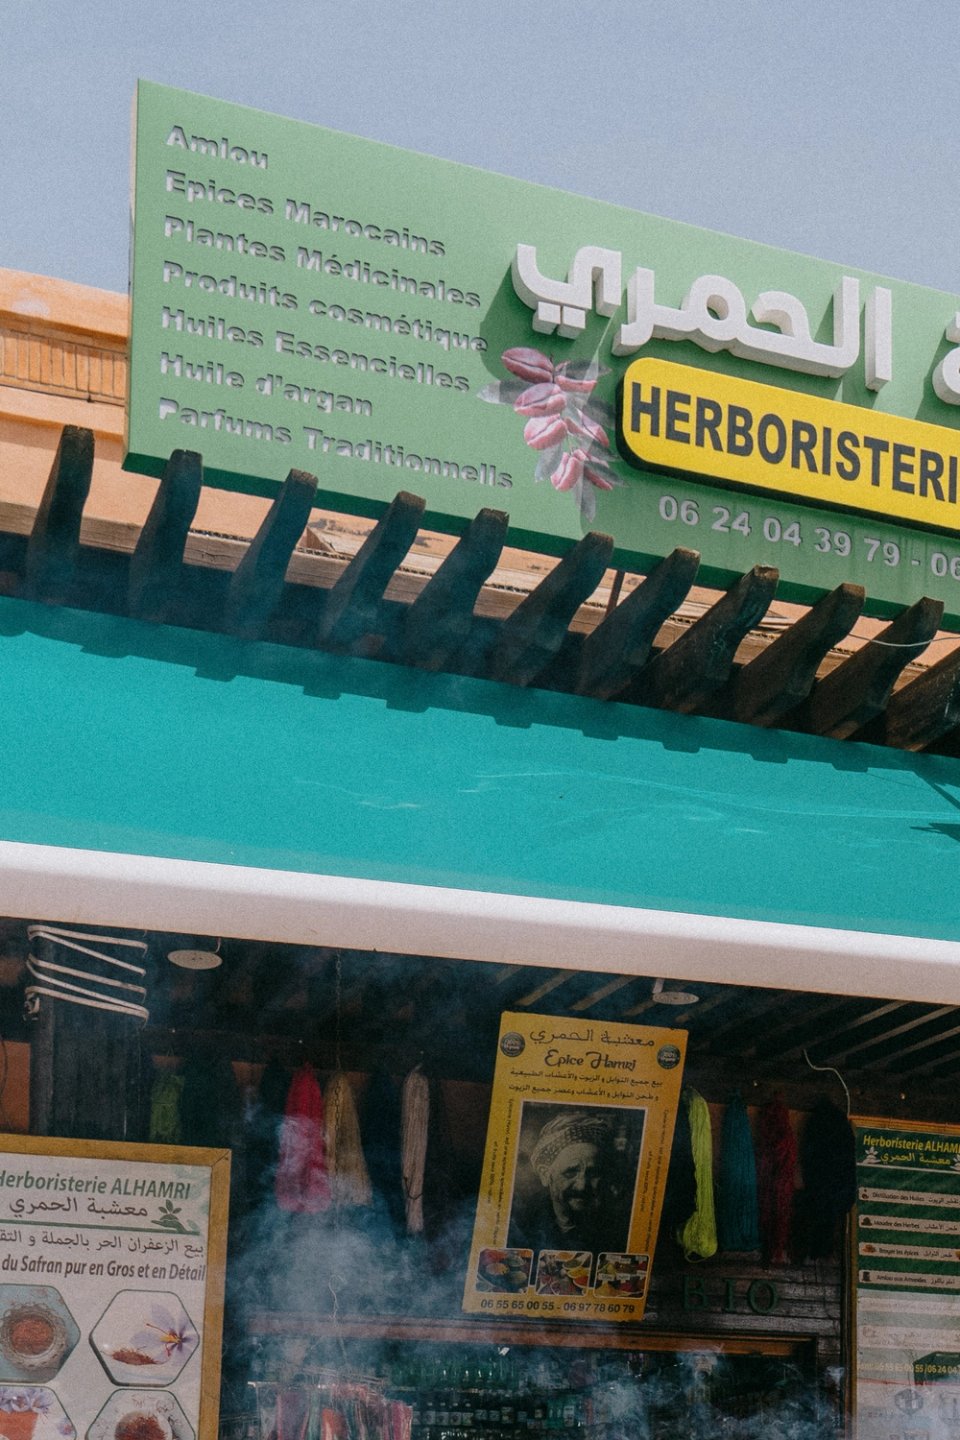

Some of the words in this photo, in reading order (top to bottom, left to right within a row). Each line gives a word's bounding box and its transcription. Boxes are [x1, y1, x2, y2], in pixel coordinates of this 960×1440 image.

[166, 125, 268, 169] Amlou
[166, 169, 274, 215] Epices
[285, 198, 446, 257] Marocains
[164, 215, 286, 262] Plantes
[297, 246, 481, 309] Médicinales
[163, 260, 298, 311] Produits
[308, 299, 489, 352] cosmétique
[512, 243, 893, 390] الحمري
[162, 306, 264, 348] Huiles
[276, 330, 470, 393] Essencielles
[160, 352, 245, 388] Huile
[256, 373, 373, 417] d'argan
[159, 397, 292, 445] Parfums
[303, 426, 514, 488] Traditionnells
[658, 495, 700, 526] 06
[711, 506, 752, 536] 24
[763, 517, 802, 547] 04
[814, 527, 852, 557] 39
[863, 537, 901, 567] 79
[529, 1029, 594, 1045] الحمري
[863, 1135, 924, 1151] Herboristerie
[110, 1178, 191, 1199] ALHAMRI
[9, 1196, 78, 1218] الحمري
[87, 1197, 148, 1219] معشبة
[28, 1235, 36, 1247] و
[41, 1230, 90, 1251] بالجملة
[96, 1236, 122, 1251] الحر
[127, 1236, 179, 1255] الزعفران
[184, 1244, 204, 1258] بيع
[1, 1253, 18, 1271] du
[20, 1255, 63, 1273] Safran
[63, 1261, 87, 1278] pur
[88, 1262, 104, 1276] en
[107, 1260, 135, 1278] Gros
[137, 1263, 150, 1279] et
[152, 1266, 167, 1279] en
[169, 1263, 206, 1281] Détail
[481, 1298, 494, 1308] 06
[496, 1299, 509, 1309] 55
[511, 1300, 524, 1309] 65
[526, 1300, 539, 1310] 00
[541, 1301, 554, 1310] 55
[563, 1302, 576, 1311] 06
[578, 1303, 591, 1312] 97
[622, 1305, 635, 1314] 79
[683, 1276, 778, 1314] BIO
